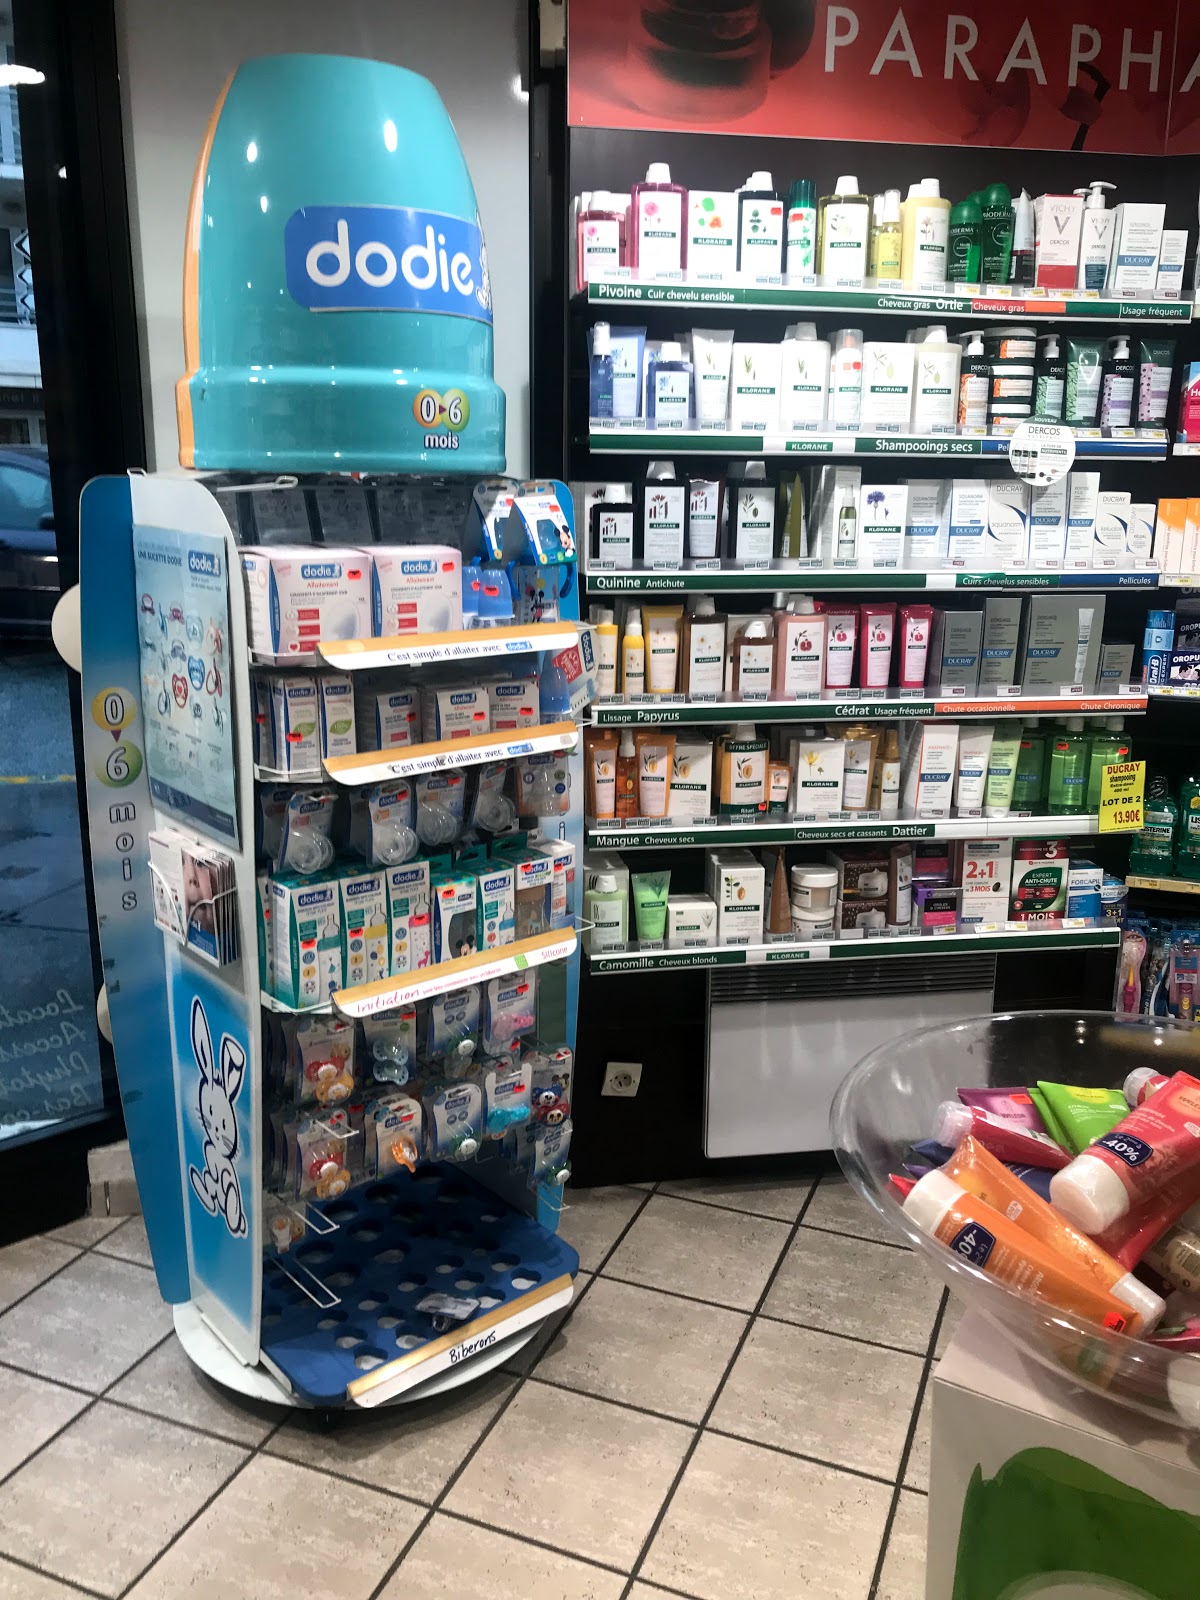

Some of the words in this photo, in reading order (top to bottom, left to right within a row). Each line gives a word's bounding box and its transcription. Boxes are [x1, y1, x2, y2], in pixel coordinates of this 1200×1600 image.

[305, 218, 474, 296] dodie
[598, 284, 643, 299] Pivoine
[647, 289, 665, 300] Cuir
[666, 289, 699, 300] chevelu
[701, 290, 735, 302] sensible
[878, 298, 912, 308] Cheveux
[913, 301, 930, 310] gras
[935, 299, 964, 311] Ortie
[973, 302, 1007, 312] Cheveux
[1008, 304, 1025, 314] gras
[1122, 306, 1147, 318] Usage
[1148, 306, 1183, 319] fréquent
[420, 394, 437, 424] 0
[448, 396, 463, 425] 6
[1028, 426, 1060, 436] DERCOS
[423, 432, 459, 450] mois
[792, 443, 828, 451] KLORANE
[875, 439, 954, 454] Shampooings
[955, 442, 973, 452] secs
[190, 553, 212, 572] dodie
[404, 562, 428, 574] dodie
[304, 564, 333, 578] dodie
[596, 576, 641, 590] Quinine
[646, 578, 685, 588] Antichute
[962, 577, 982, 586] Cuirs
[984, 577, 1015, 586] chevelus
[1016, 577, 1050, 586] sensibles
[1118, 576, 1152, 585] Pellicules
[387, 652, 411, 662] C'est
[412, 649, 442, 660] simple
[444, 646, 480, 657] d'allaiter
[482, 645, 501, 653] avec
[1150, 658, 1160, 684] Oral-B
[496, 686, 518, 695] dodie
[452, 694, 470, 704] dodie
[104, 693, 124, 725] 0
[835, 704, 870, 716] Cédrat
[874, 708, 898, 718] Usage
[899, 706, 932, 716] fréquent
[942, 704, 964, 713] Chute
[964, 704, 1016, 713] occasionnelle
[1080, 702, 1102, 711] Chute
[1102, 701, 1140, 712] Chronique
[602, 714, 632, 724] Lissage
[637, 710, 680, 724] Papyrus
[106, 746, 130, 783] 6
[416, 756, 446, 770] simple
[447, 752, 482, 766] d'allaiter
[484, 750, 504, 759] avec
[1107, 762, 1141, 775] DUCRAY
[1110, 773, 1136, 783] shampooing
[1102, 798, 1120, 806] LOT
[1113, 810, 1140, 824] 13.90€
[797, 830, 826, 840] Cheveux
[854, 829, 888, 838] cassants
[892, 826, 928, 837] Dattier
[596, 836, 640, 848] Mangue
[644, 836, 676, 845] Cheveux
[678, 836, 695, 844] secs
[1044, 840, 1058, 858] 3
[966, 861, 994, 878] 2+1
[394, 872, 416, 882] dodie
[348, 883, 372, 894] dodie
[485, 880, 504, 890] dodie
[300, 892, 324, 905] dodie
[1028, 912, 1055, 920] MOIS
[541, 946, 568, 960] Silicone
[771, 952, 806, 960] KLORANE
[599, 958, 654, 970] Camomille
[658, 958, 688, 967] Cheveux
[688, 956, 718, 966] blonds
[357, 988, 420, 1014] Initiation
[1102, 1137, 1138, 1162] -40%
[448, 1330, 496, 1364] Biberons
